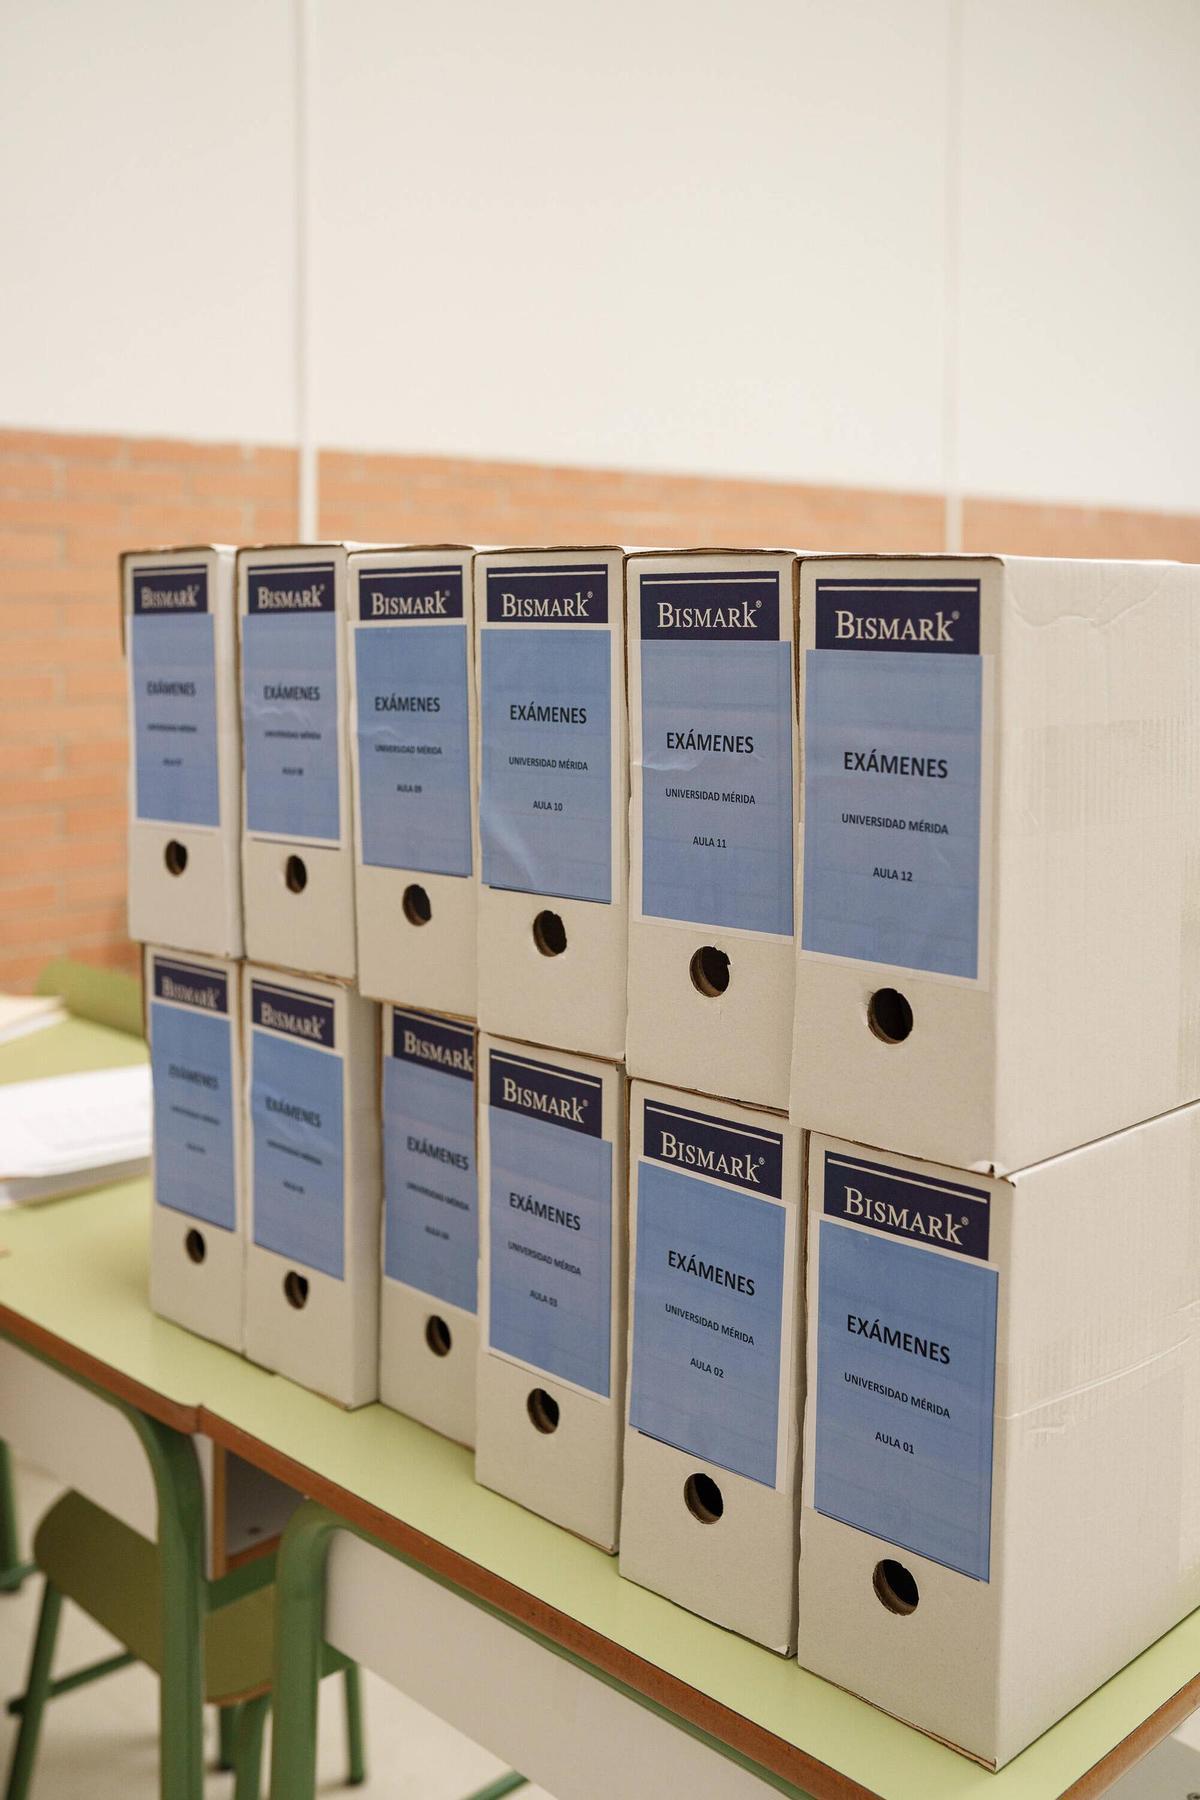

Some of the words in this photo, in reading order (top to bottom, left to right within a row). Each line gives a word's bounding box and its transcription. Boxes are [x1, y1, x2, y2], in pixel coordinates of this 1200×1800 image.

[263, 685, 321, 701] EXÁMENES
[374, 693, 441, 713] EXÁMENES
[510, 701, 587, 725] EXÁMENES
[666, 729, 754, 754] EXÁMENES
[508, 756, 557, 769] UNIVERSIDAD
[558, 758, 589, 771] MÉRIDA
[844, 748, 948, 779] EXÁMENES
[532, 800, 552, 811] AULA
[553, 802, 564, 812] 10
[665, 787, 721, 802] UNIVERSIDAD
[722, 791, 756, 805] MÉRIDA
[841, 813, 907, 830] UNIVERSIDAD
[908, 819, 949, 835] MÉRIDA
[692, 835, 716, 847] AULA
[716, 838, 727, 849] 11
[872, 867, 899, 881] AULA
[900, 870, 913, 882] 12
[406, 1135, 470, 1172] EXÁMENES
[509, 1192, 581, 1232] EXÁMENES
[507, 1241, 553, 1265] UNIVERSIDAD
[553, 1258, 582, 1276] MÉRIDA
[668, 1250, 755, 1297] EXÁMENES
[529, 1289, 547, 1303] AULA
[665, 1303, 720, 1332] UNIVERSIDAD
[721, 1324, 755, 1346] MÉRIDA
[847, 1314, 951, 1365] EXÁMENES
[689, 1357, 713, 1374] AULA
[713, 1366, 724, 1379] 02
[844, 1371, 909, 1403] UNIVERSIDAD
[910, 1395, 951, 1420] MÉRIDA
[874, 1431, 901, 1450] AULA
[902, 1441, 915, 1455] 01
